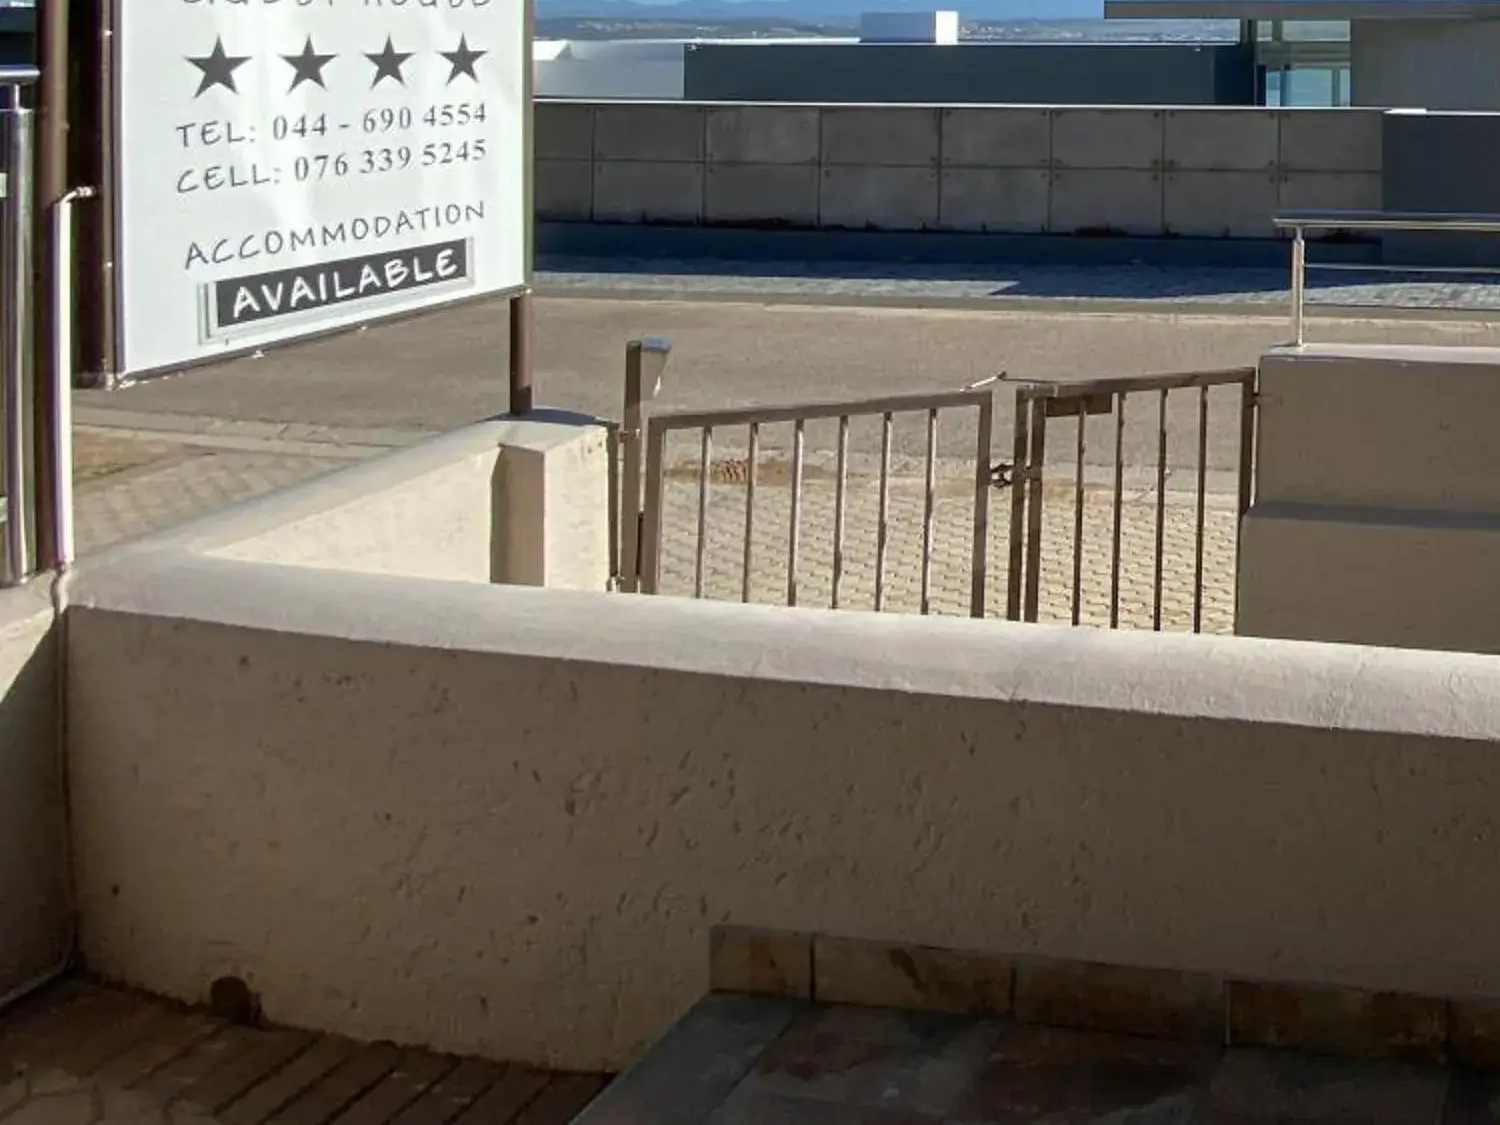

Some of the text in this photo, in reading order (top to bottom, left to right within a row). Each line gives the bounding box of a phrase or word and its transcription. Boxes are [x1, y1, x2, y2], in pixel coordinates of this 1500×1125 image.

[175, 121, 256, 149] TEL:
[272, 113, 328, 141] 044
[362, 106, 413, 132] 690
[422, 102, 488, 128] 4554
[175, 139, 488, 195] CELL: 076 339 5245
[184, 200, 486, 269] ACCOMMODATION
[231, 248, 460, 319] AVAILABLE
